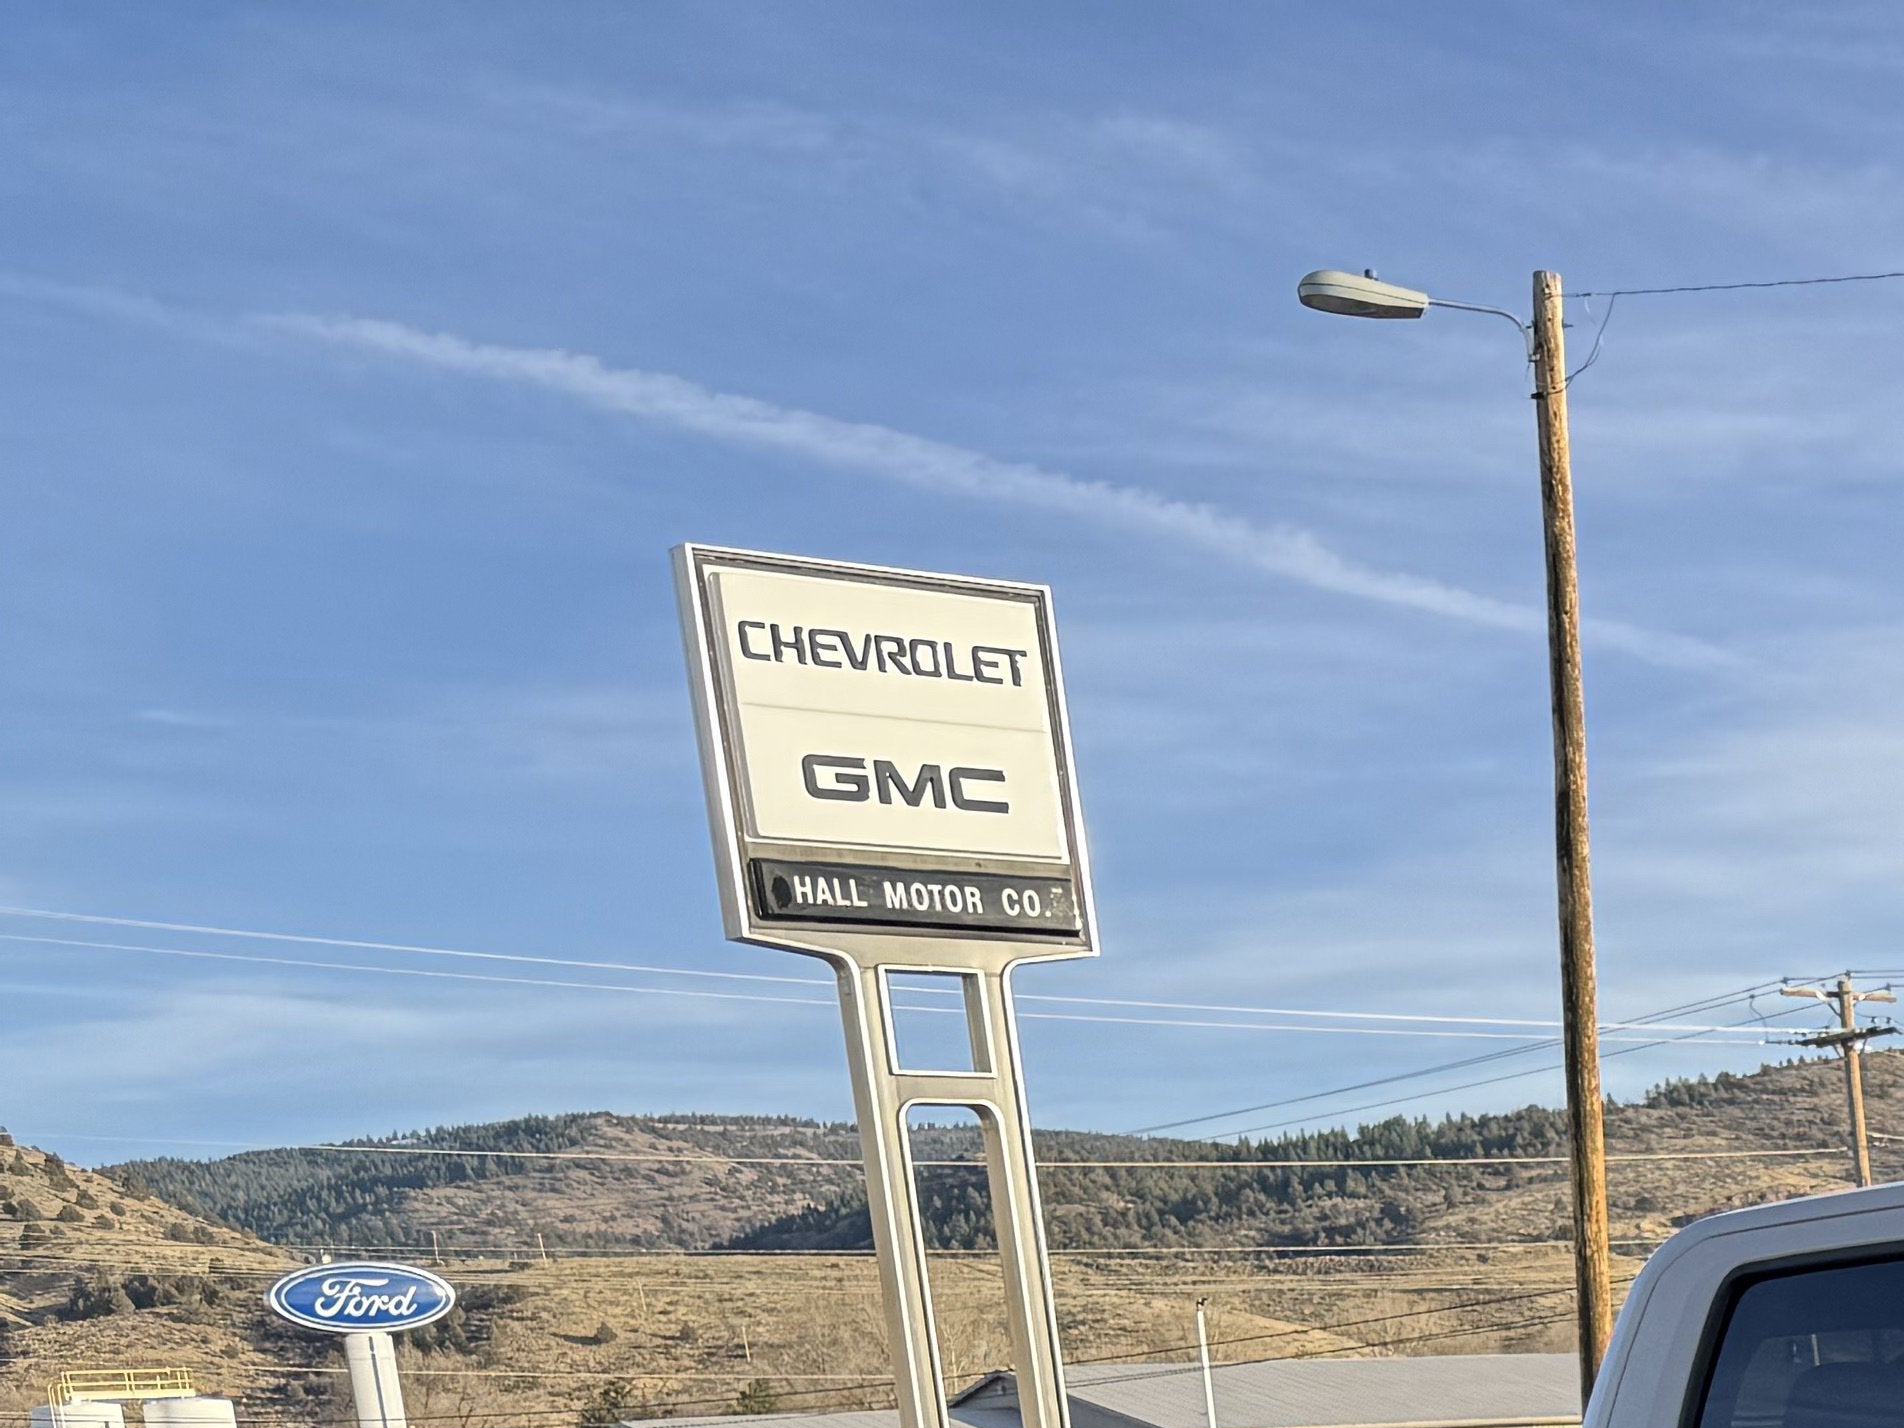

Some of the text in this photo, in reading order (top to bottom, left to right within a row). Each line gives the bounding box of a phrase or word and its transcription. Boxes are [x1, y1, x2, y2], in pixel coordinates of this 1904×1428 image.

[738, 620, 1027, 687] CHEVROLET
[801, 754, 1009, 814] GMC
[793, 875, 1052, 917] HALL MOTOR CO.
[314, 1277, 417, 1318] Ford
